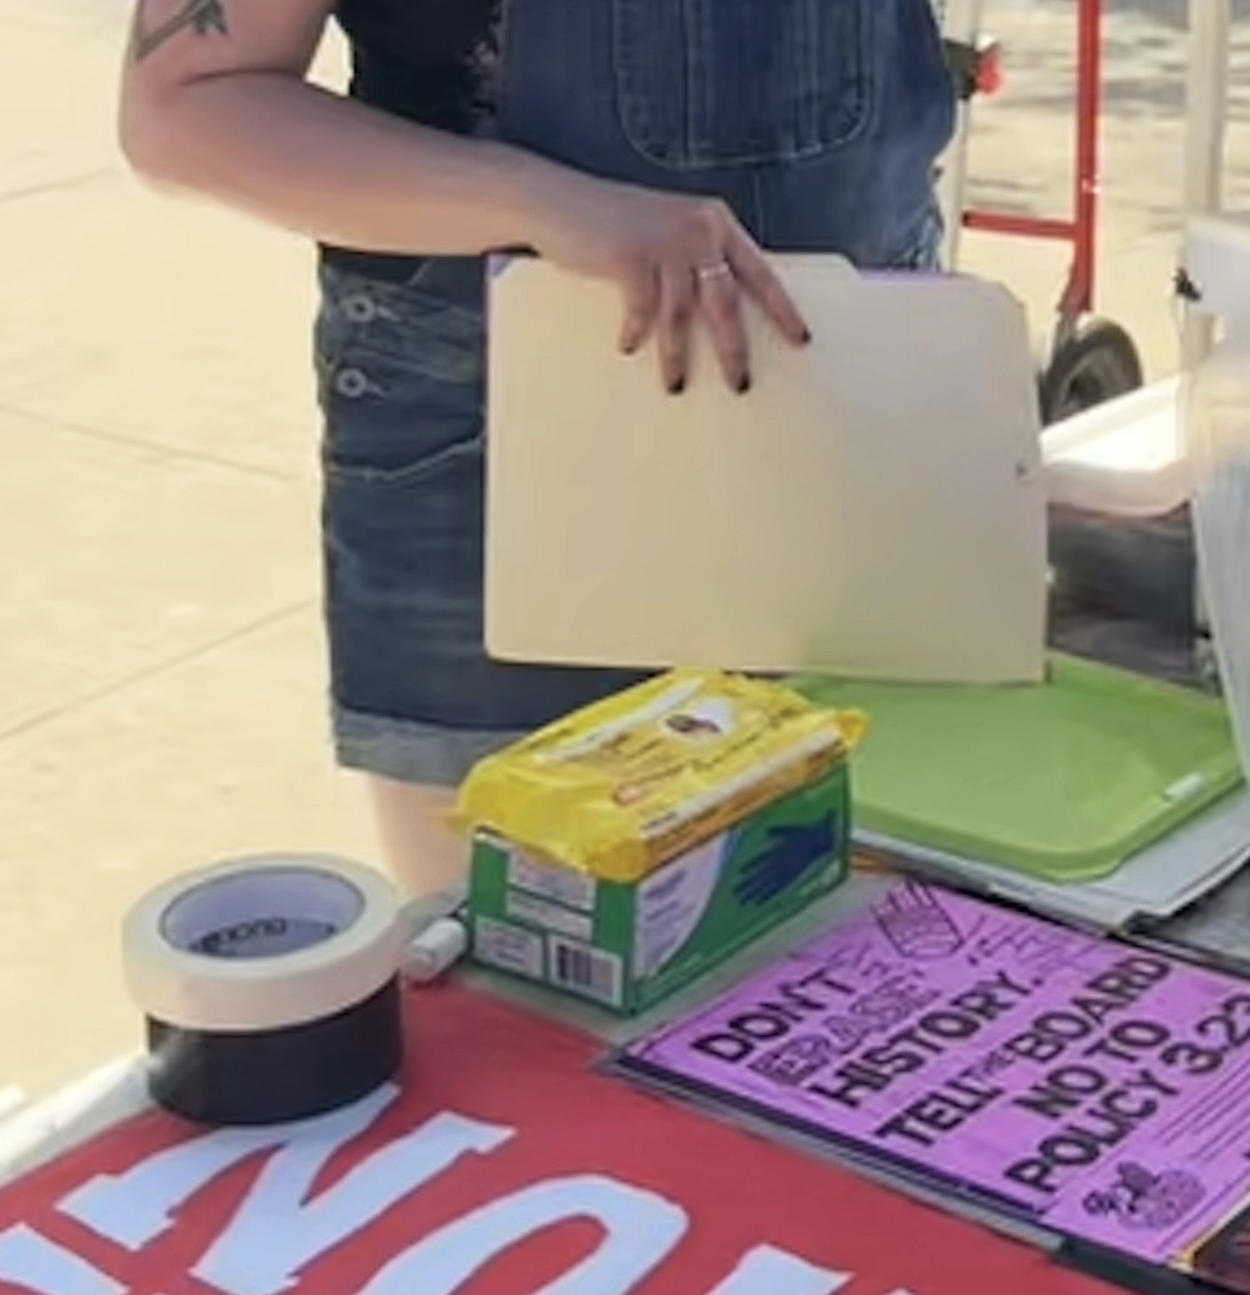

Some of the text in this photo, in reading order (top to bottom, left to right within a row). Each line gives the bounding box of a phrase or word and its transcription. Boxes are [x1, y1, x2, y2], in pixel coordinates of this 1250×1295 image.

[806, 969, 1044, 1109] HISTORY.
[874, 1076, 1005, 1148] TELL
[1004, 955, 1172, 1063] BOARD
[1013, 1019, 1172, 1120] NO TO
[1004, 1069, 1181, 1194] POLICY
